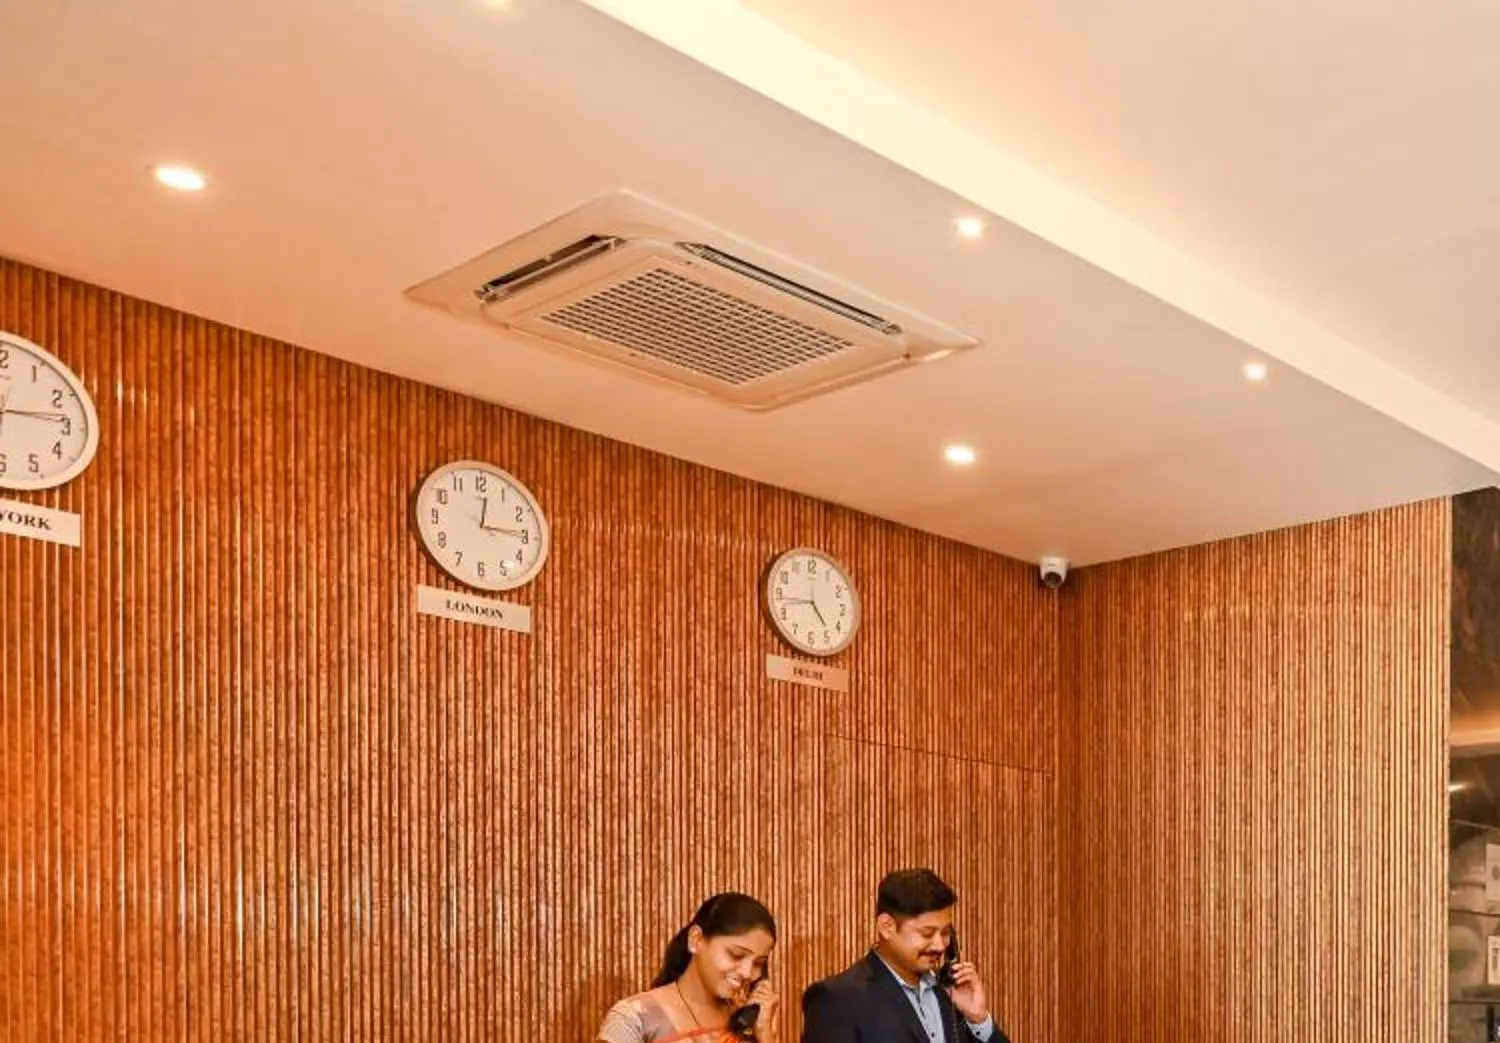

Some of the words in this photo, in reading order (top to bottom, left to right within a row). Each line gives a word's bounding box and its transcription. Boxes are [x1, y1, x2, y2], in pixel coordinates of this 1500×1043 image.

[52, 389, 63, 408] 2
[61, 417, 71, 435] 3
[52, 441, 62, 459] 4
[28, 454, 39, 472] 5
[453, 477, 463, 492] 11
[475, 477, 487, 493] 12
[437, 489, 448, 504] 10
[431, 508, 439, 524] 9
[515, 506, 523, 522] 2
[437, 532, 447, 549] 8
[521, 529, 529, 544] 3
[455, 551, 463, 567] 7
[515, 549, 523, 564] 4
[477, 562, 485, 577] 6
[500, 560, 507, 576] 5
[446, 600, 504, 619] LONDON
